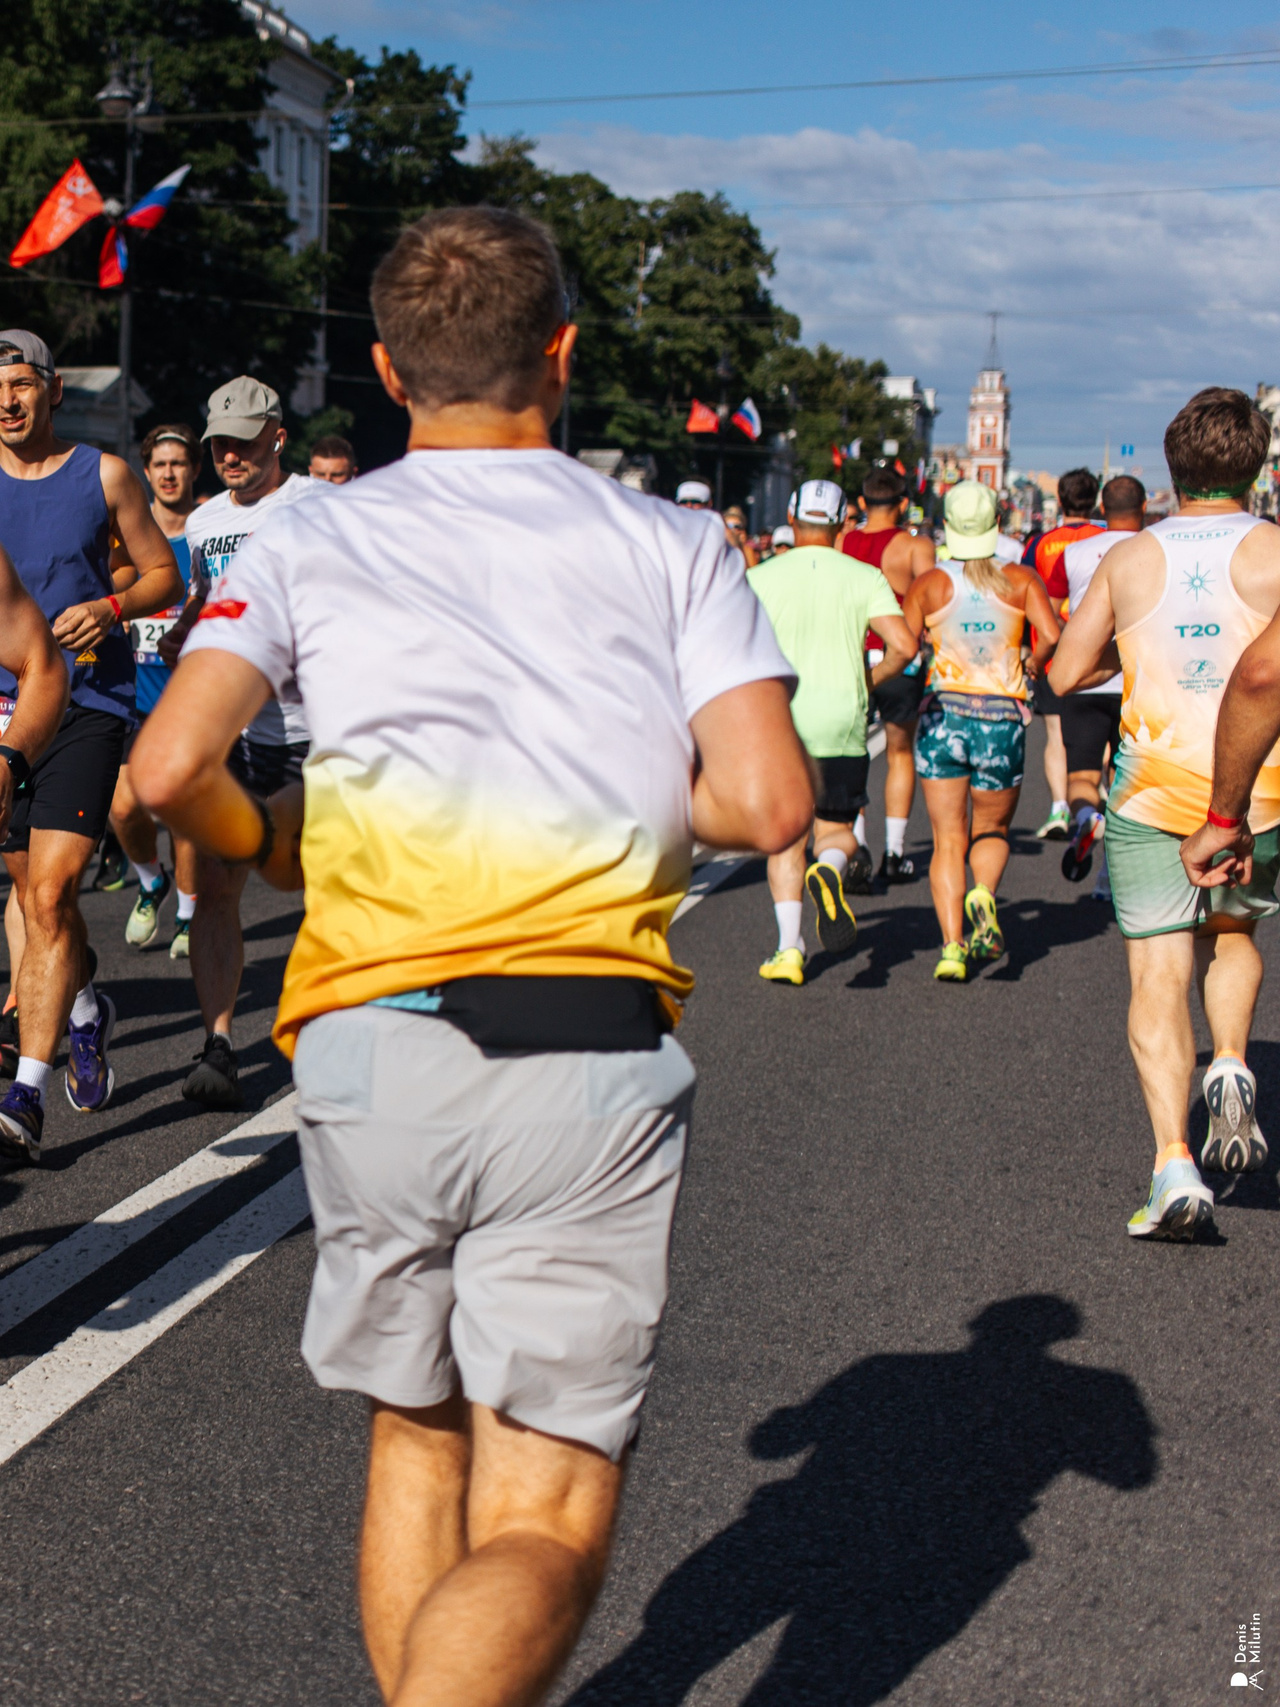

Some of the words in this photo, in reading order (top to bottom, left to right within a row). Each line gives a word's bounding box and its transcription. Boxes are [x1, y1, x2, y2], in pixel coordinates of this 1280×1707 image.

[200, 532, 254, 558] #ЗАБЕГ
[960, 621, 996, 633] T30
[1174, 623, 1221, 639] T20
